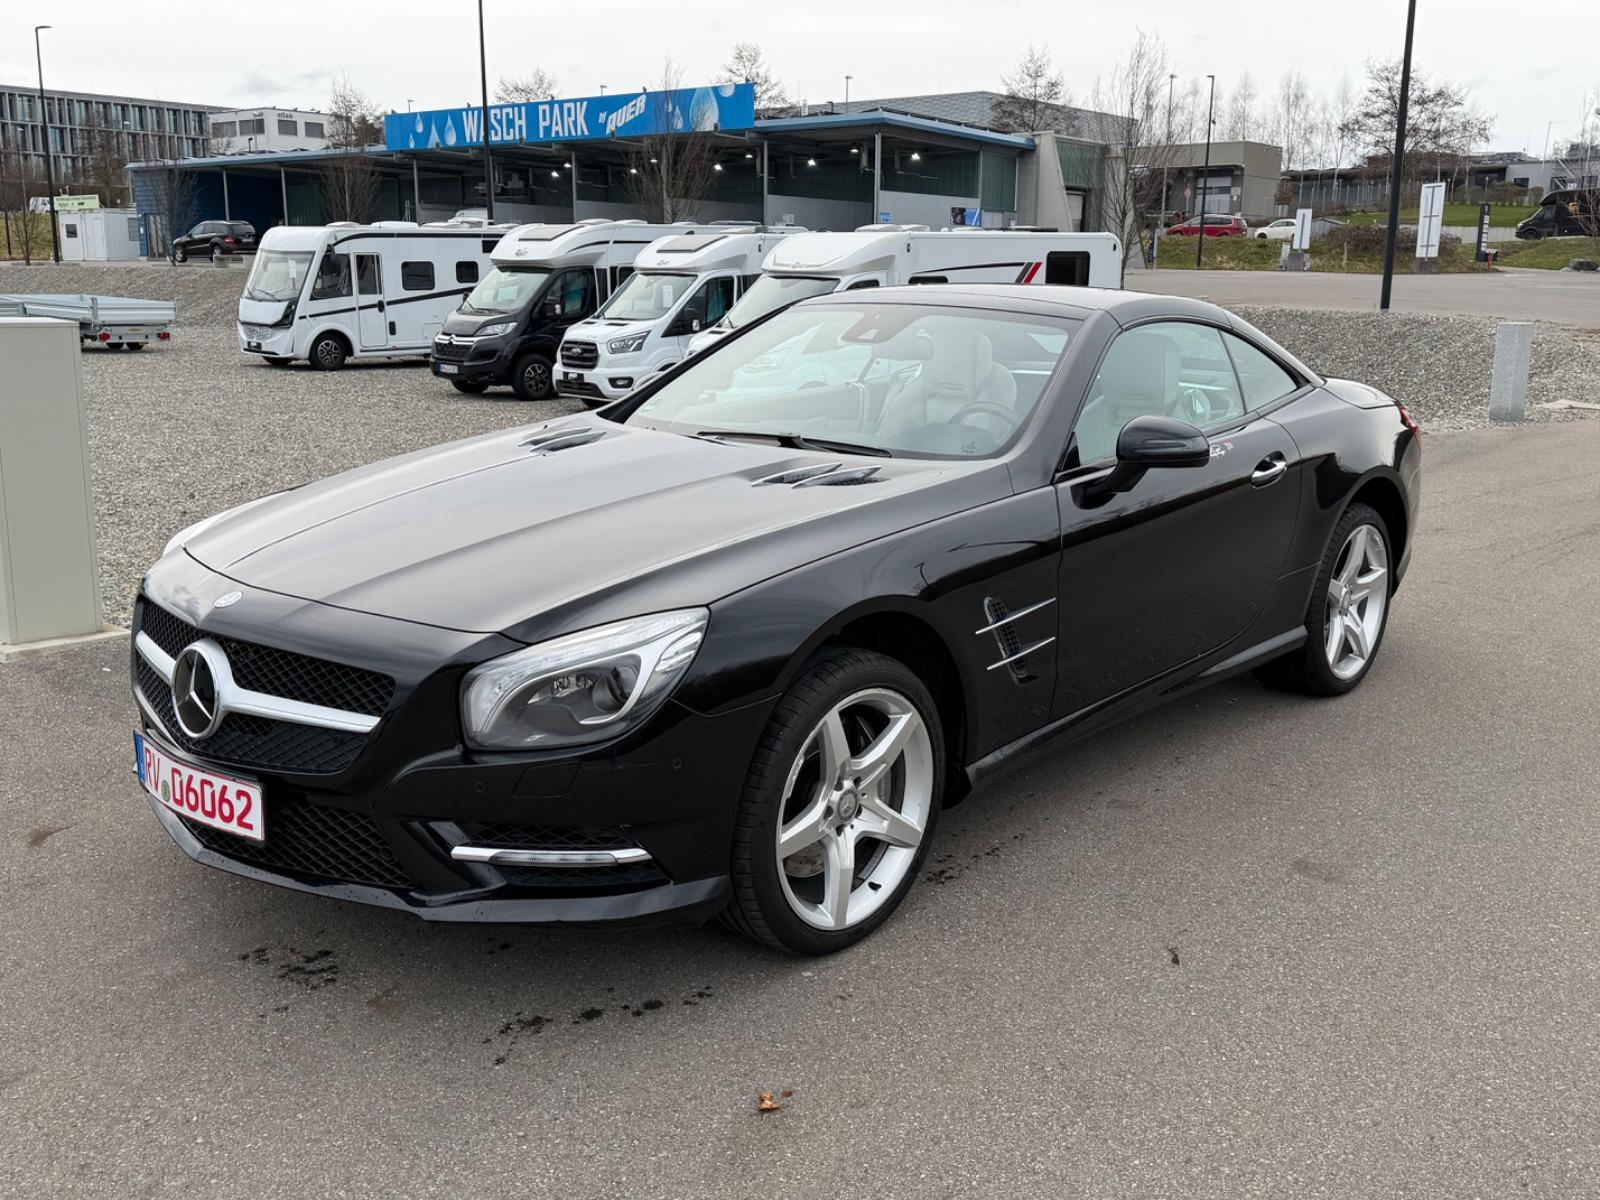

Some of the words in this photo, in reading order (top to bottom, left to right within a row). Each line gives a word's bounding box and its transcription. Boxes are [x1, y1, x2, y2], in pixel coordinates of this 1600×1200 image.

[538, 101, 589, 138] PARK
[606, 94, 647, 135] AUER
[144, 746, 160, 793] RV
[171, 767, 254, 831] 06062
